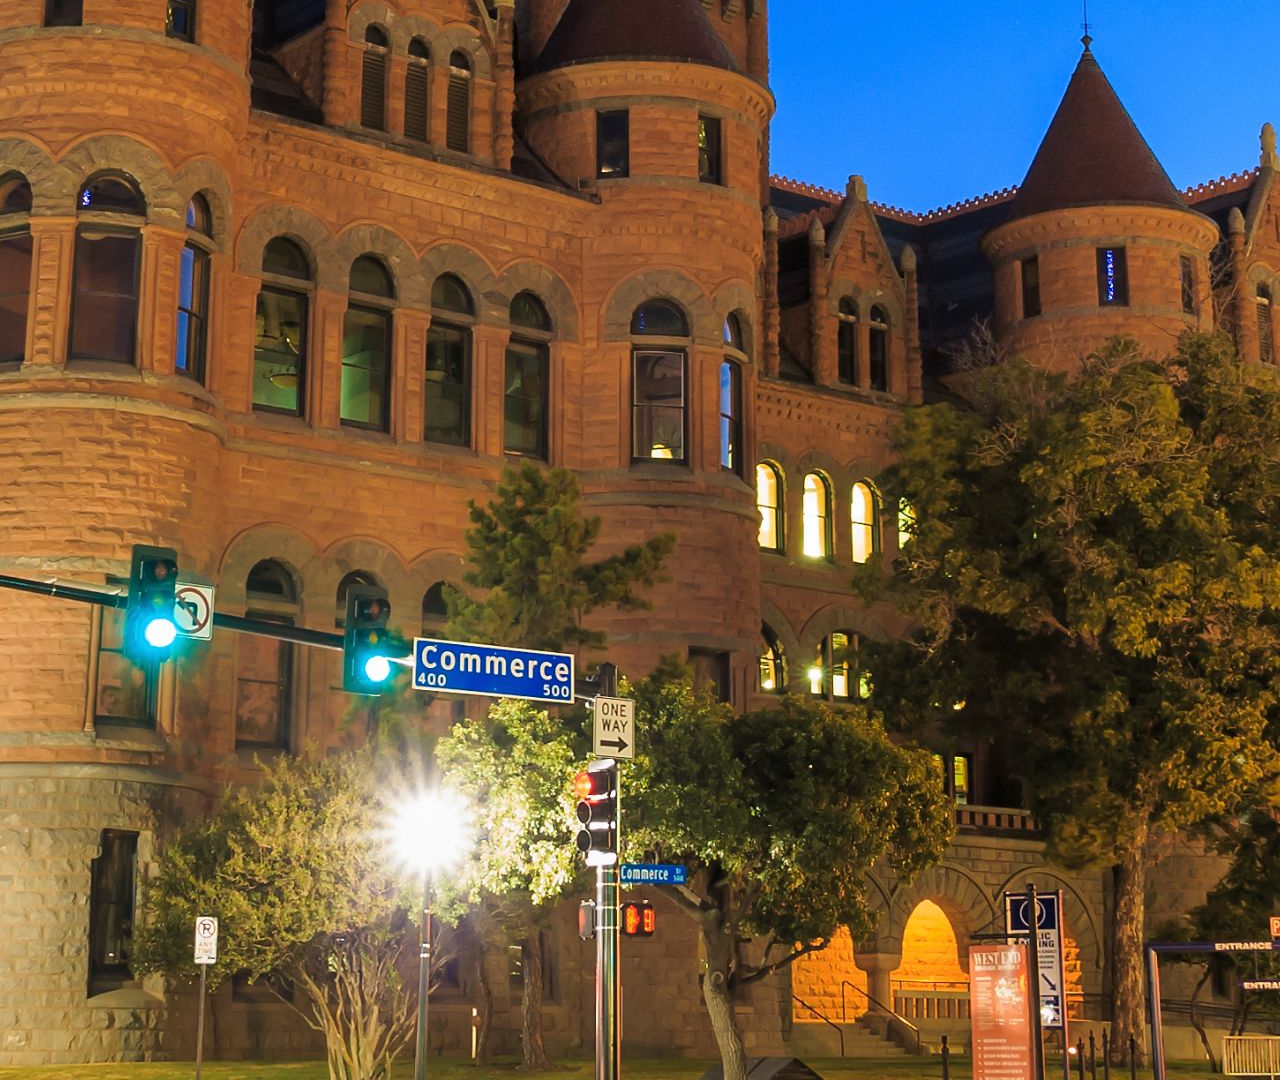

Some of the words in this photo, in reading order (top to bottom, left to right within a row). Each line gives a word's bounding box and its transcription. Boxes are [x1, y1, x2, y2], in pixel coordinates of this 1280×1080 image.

[421, 645, 569, 683] Commerce
[418, 672, 447, 687] 400
[543, 684, 570, 698] 500
[601, 702, 627, 718] ONE
[601, 718, 628, 733] WAY
[620, 865, 669, 880] Commerce
[1214, 941, 1273, 951] ENTRANCE
[973, 952, 999, 966] WEST
